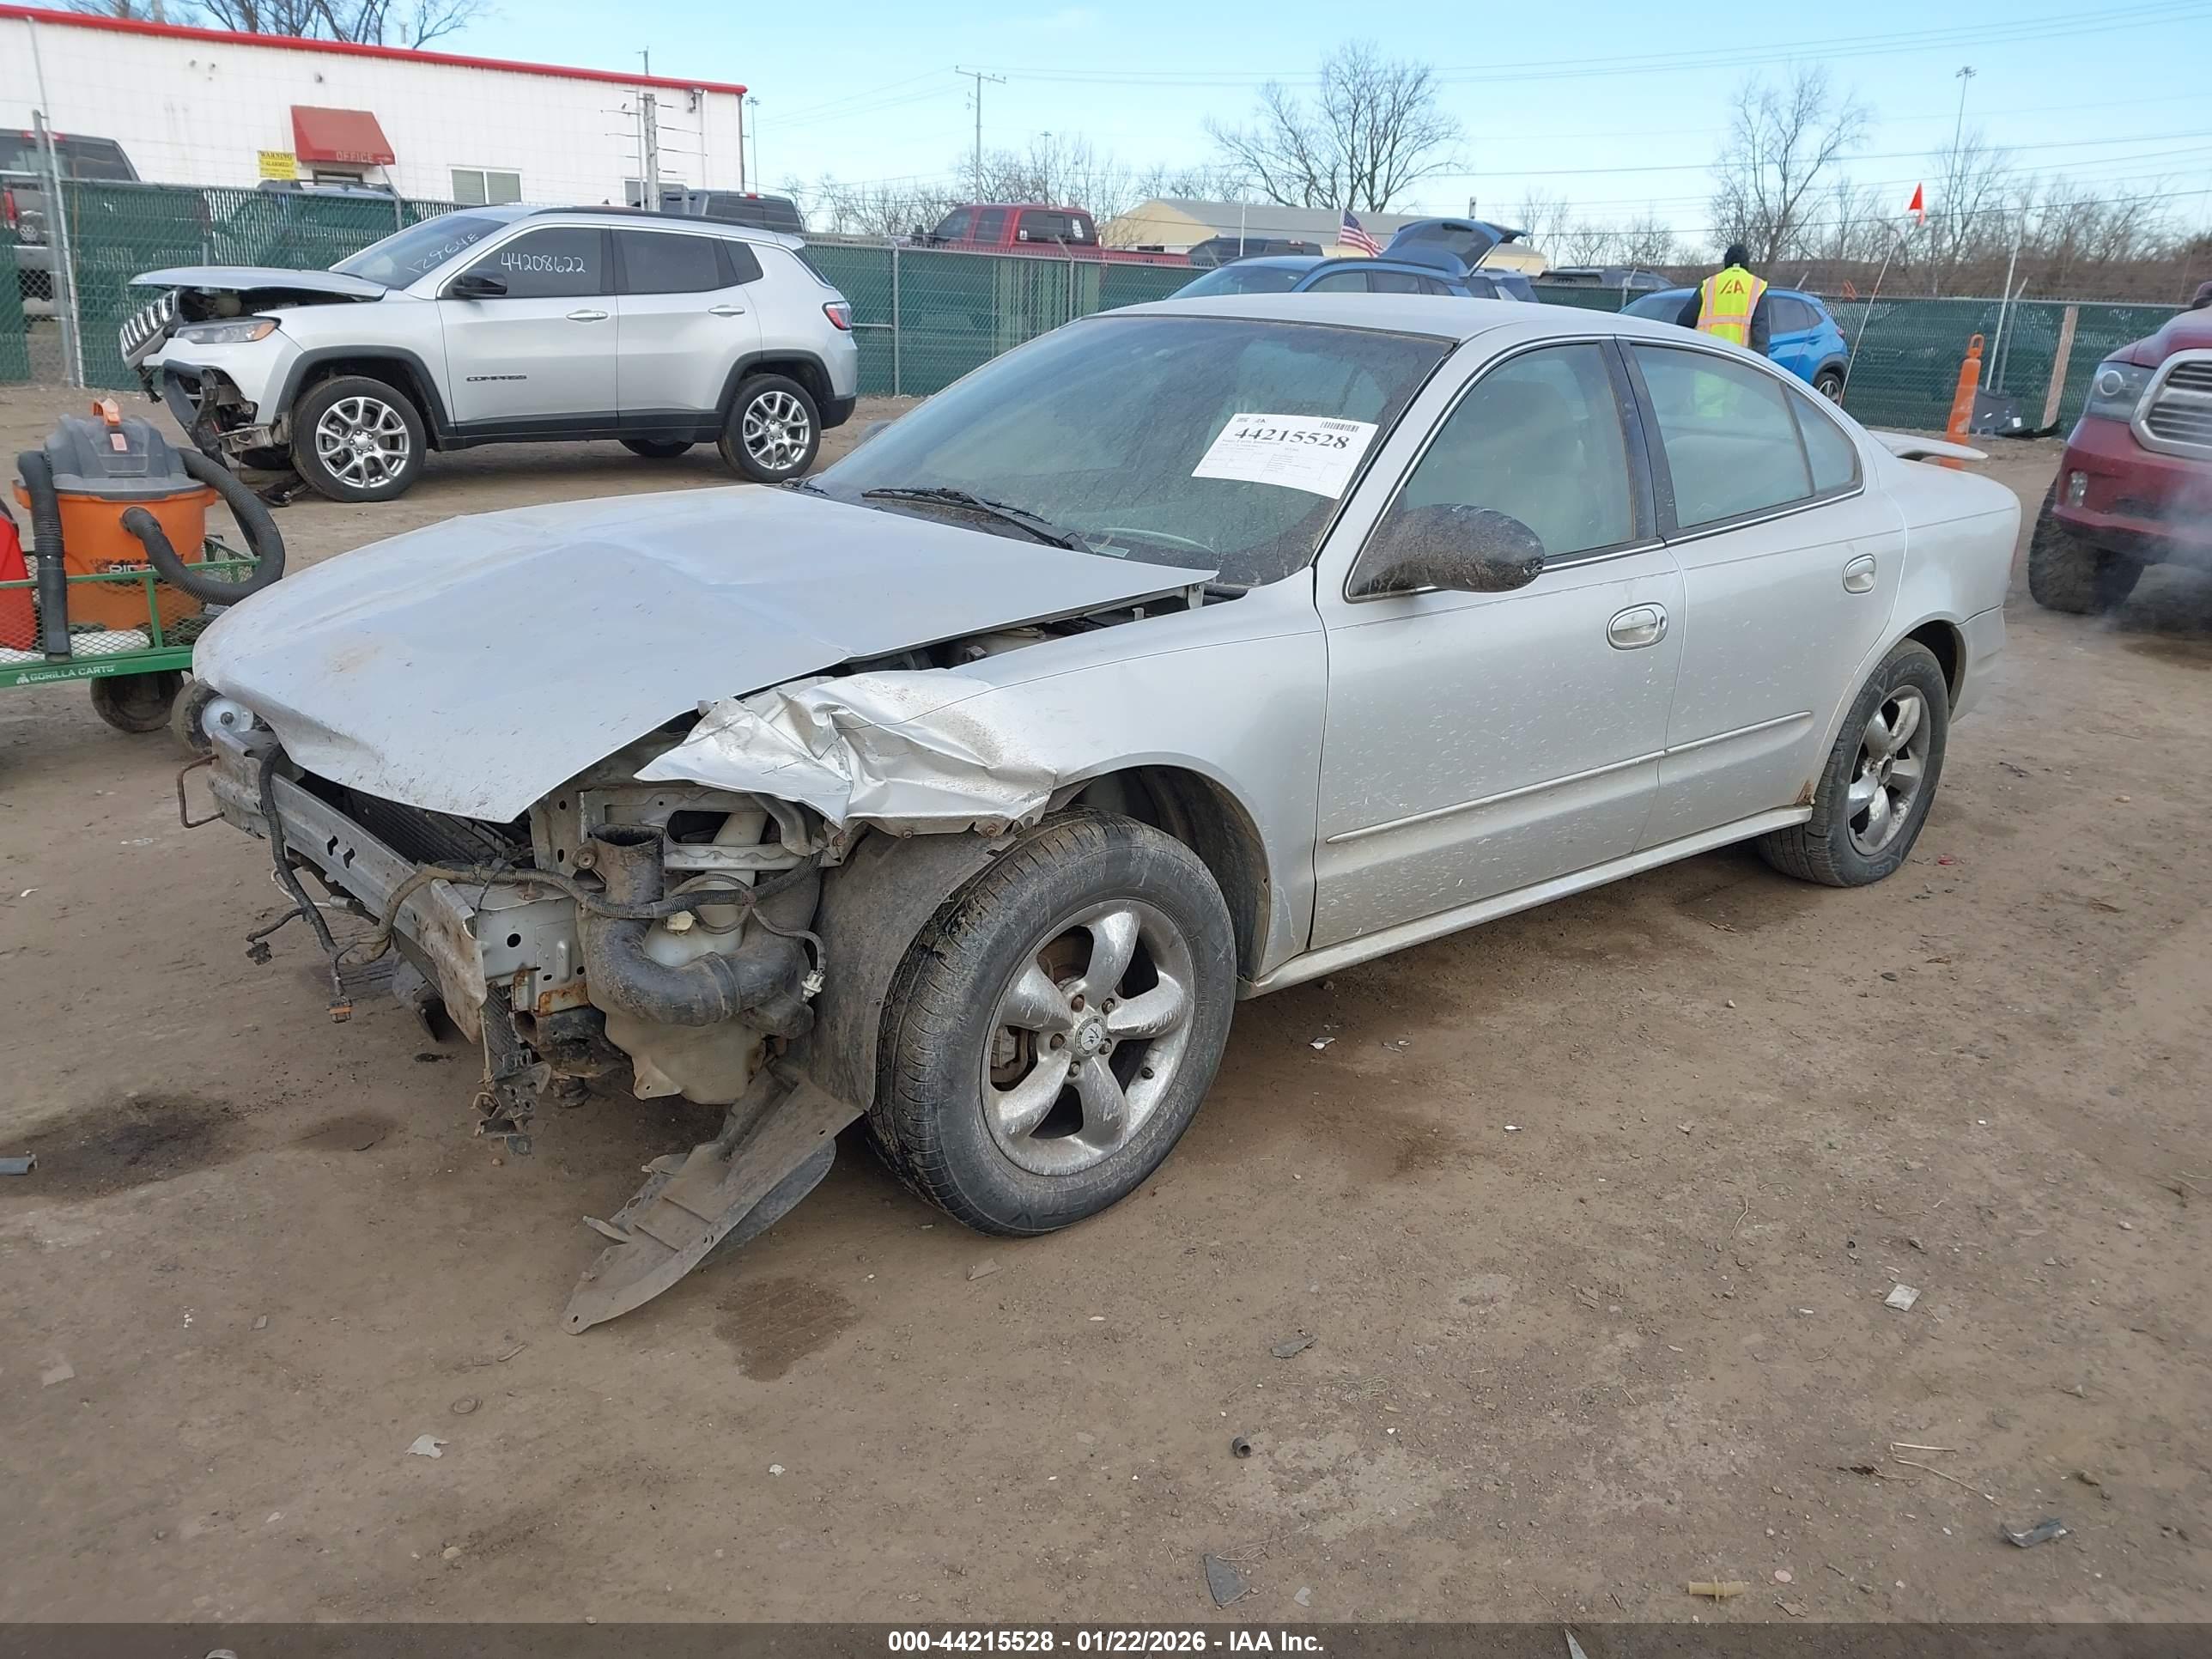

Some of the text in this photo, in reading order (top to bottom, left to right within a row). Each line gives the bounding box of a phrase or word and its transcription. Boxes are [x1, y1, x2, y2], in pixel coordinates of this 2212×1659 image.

[336, 150, 373, 163] OFFICE
[501, 252, 586, 273] 44208622
[1234, 427, 1350, 450] 44215528
[30, 665, 116, 681] GORILLA CARTS
